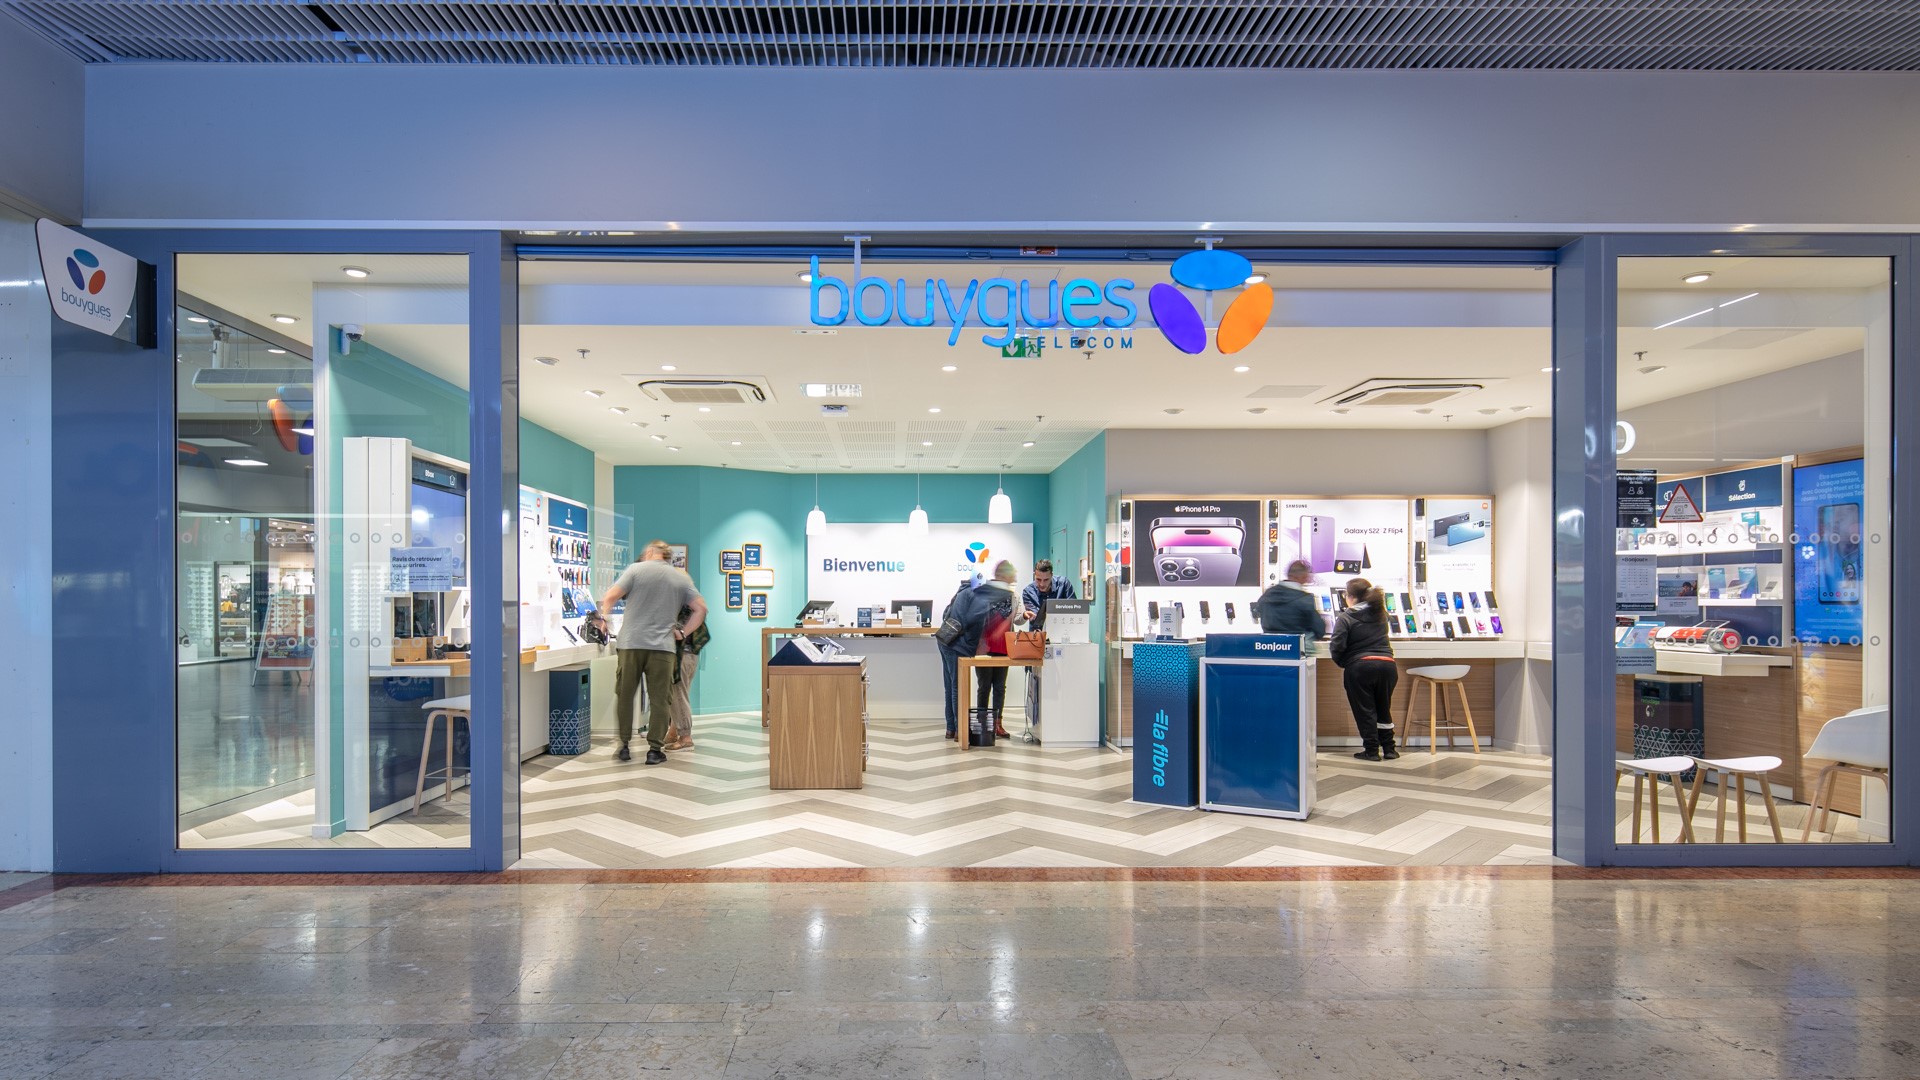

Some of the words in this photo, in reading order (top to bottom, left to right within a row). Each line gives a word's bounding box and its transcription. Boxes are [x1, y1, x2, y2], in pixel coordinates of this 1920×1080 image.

[61, 286, 111, 317] bouygues
[810, 255, 1137, 347] bouygues
[1020, 336, 1133, 349] TELECOM
[1728, 492, 1756, 502] Sélection
[1388, 528, 1404, 536] Flip4
[823, 558, 905, 572] Bienvenue
[1255, 642, 1292, 652] Bonjour
[1153, 722, 1169, 740] la
[1153, 742, 1169, 788] fibre
